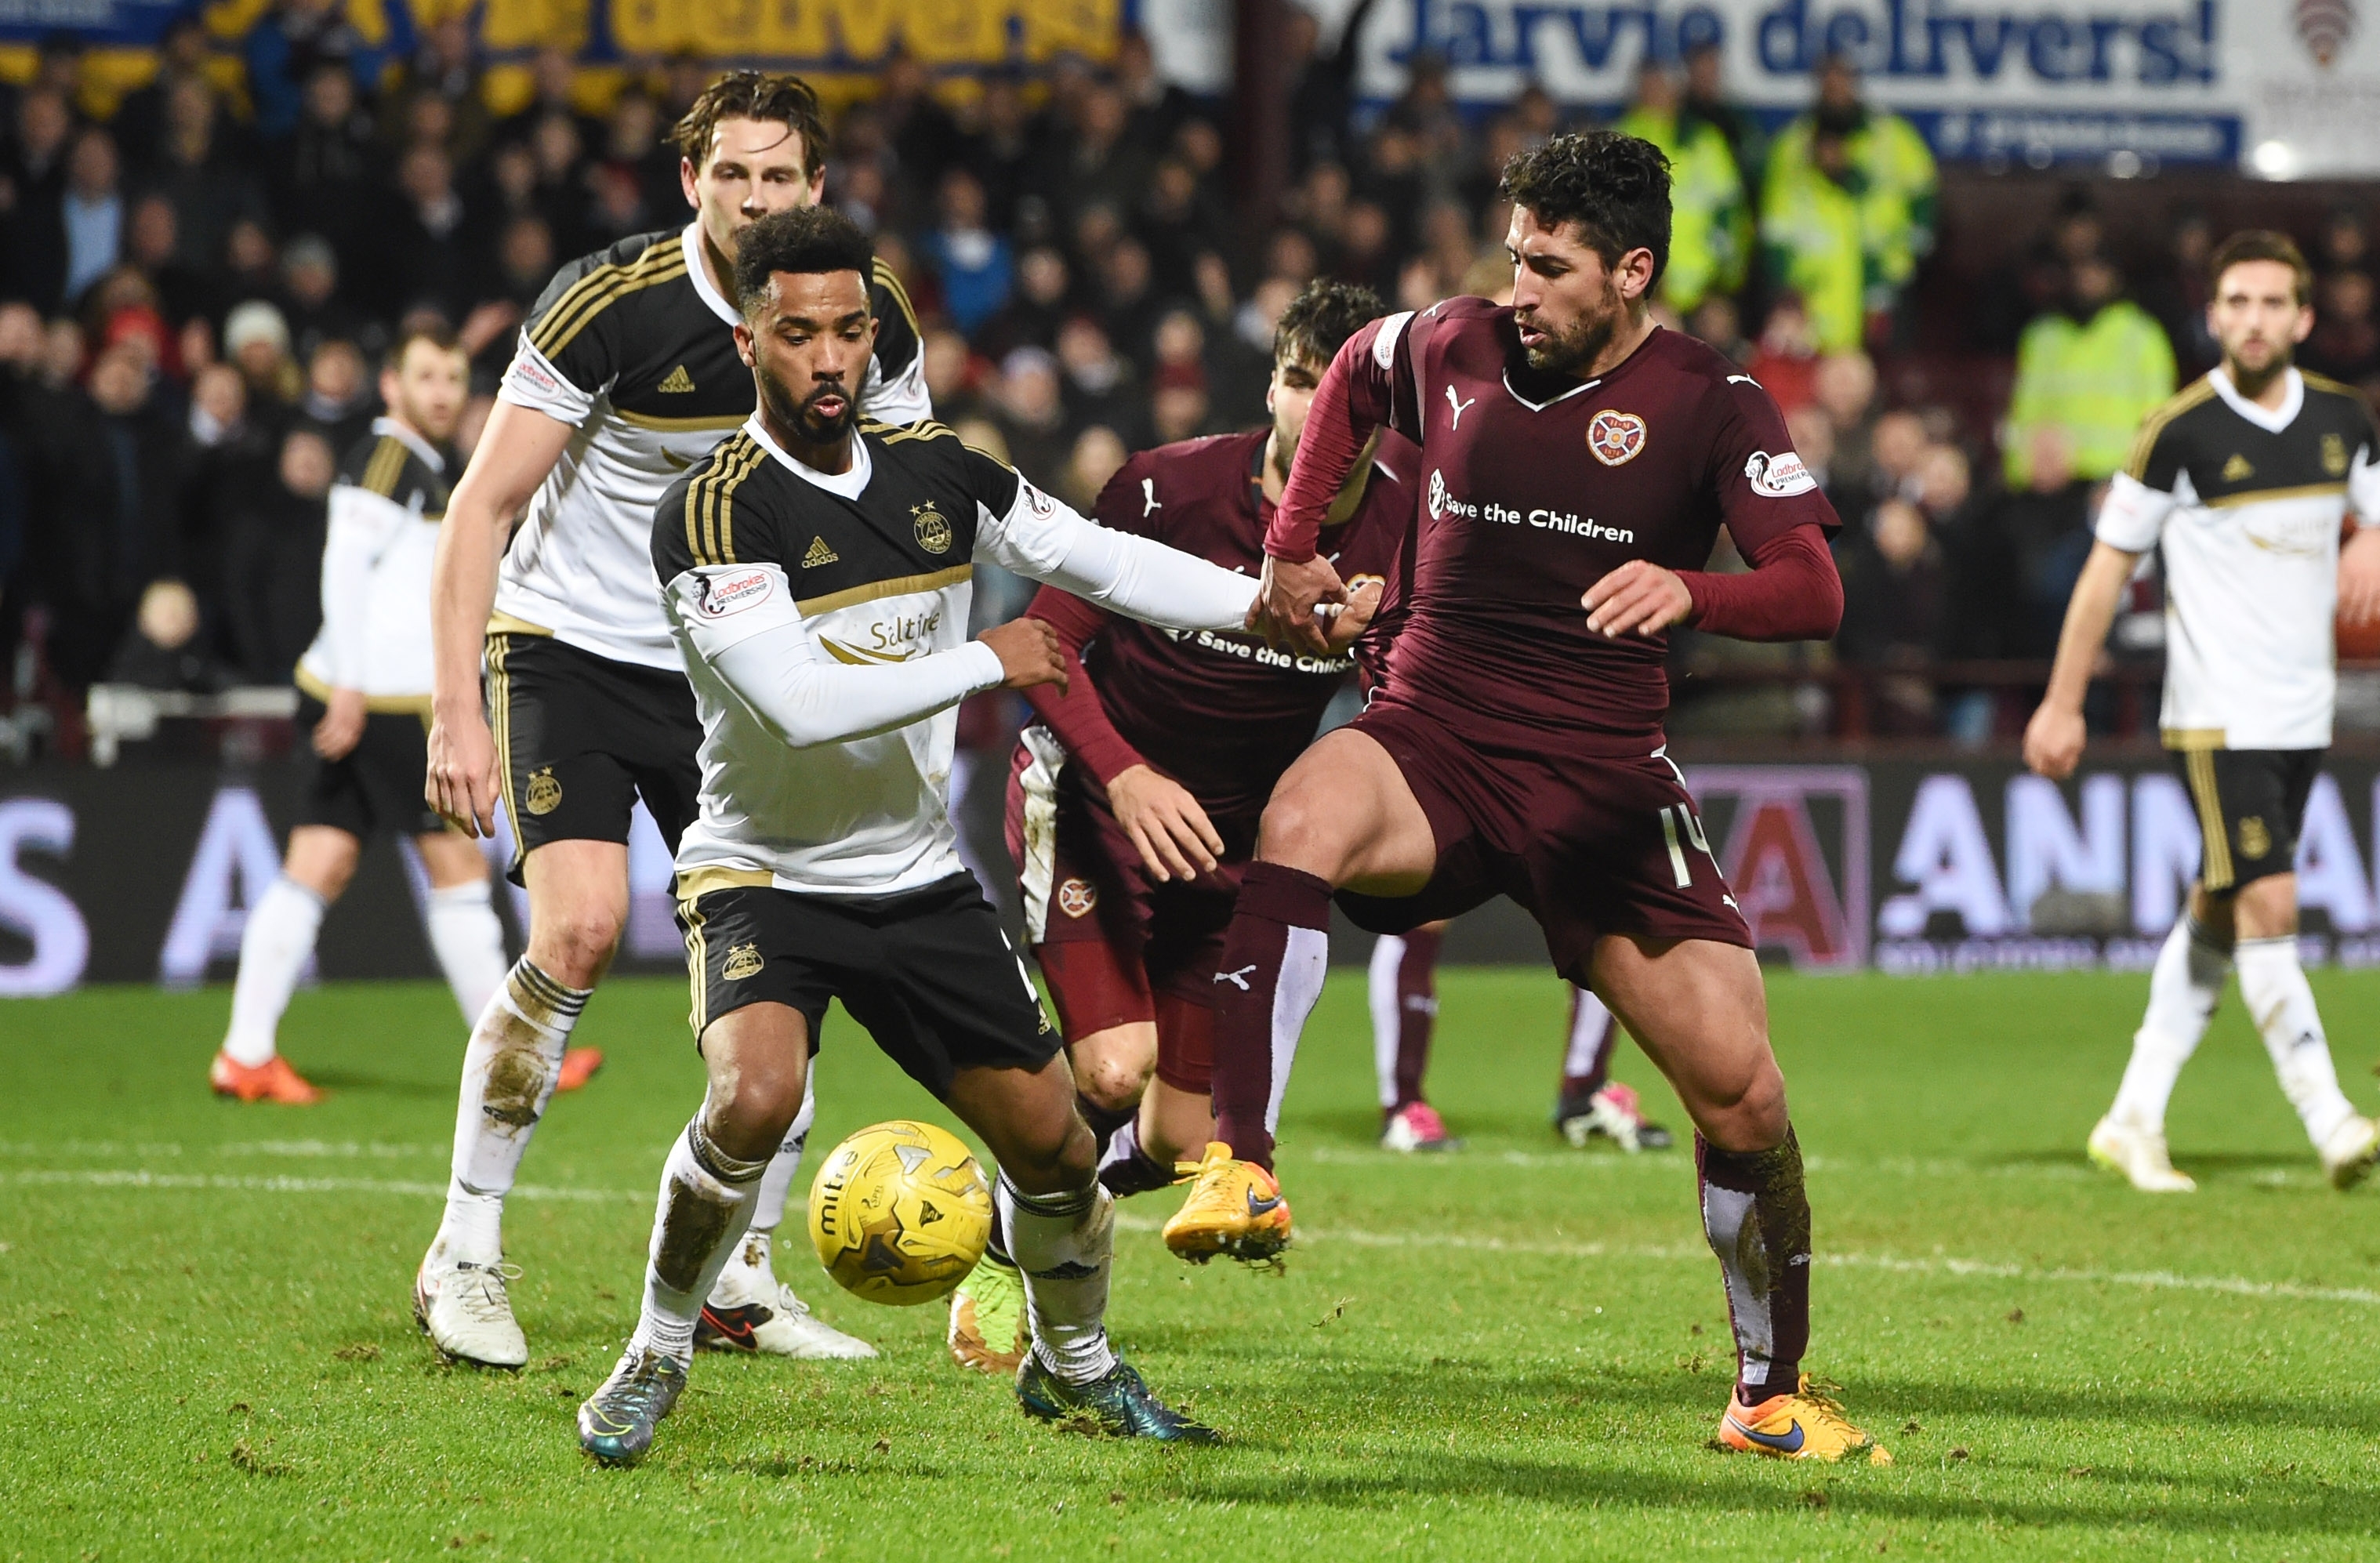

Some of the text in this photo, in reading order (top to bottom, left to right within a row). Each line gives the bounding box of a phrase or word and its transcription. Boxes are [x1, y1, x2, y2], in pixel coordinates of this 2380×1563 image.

[1755, 0, 2217, 85] delivers!
[1772, 462, 1806, 478] Ladbro
[1446, 492, 1634, 544] Save the Children
[801, 553, 839, 569] adidas
[712, 573, 765, 600] Ladbrokes
[717, 583, 767, 607] PREMIERSHIP
[871, 612, 940, 650] Saltire
[1197, 629, 1250, 659] Save
[1255, 647, 1292, 669] the
[1658, 801, 1723, 890] 14
[1876, 771, 2380, 937] ANNA
[821, 1151, 858, 1235] mitre
